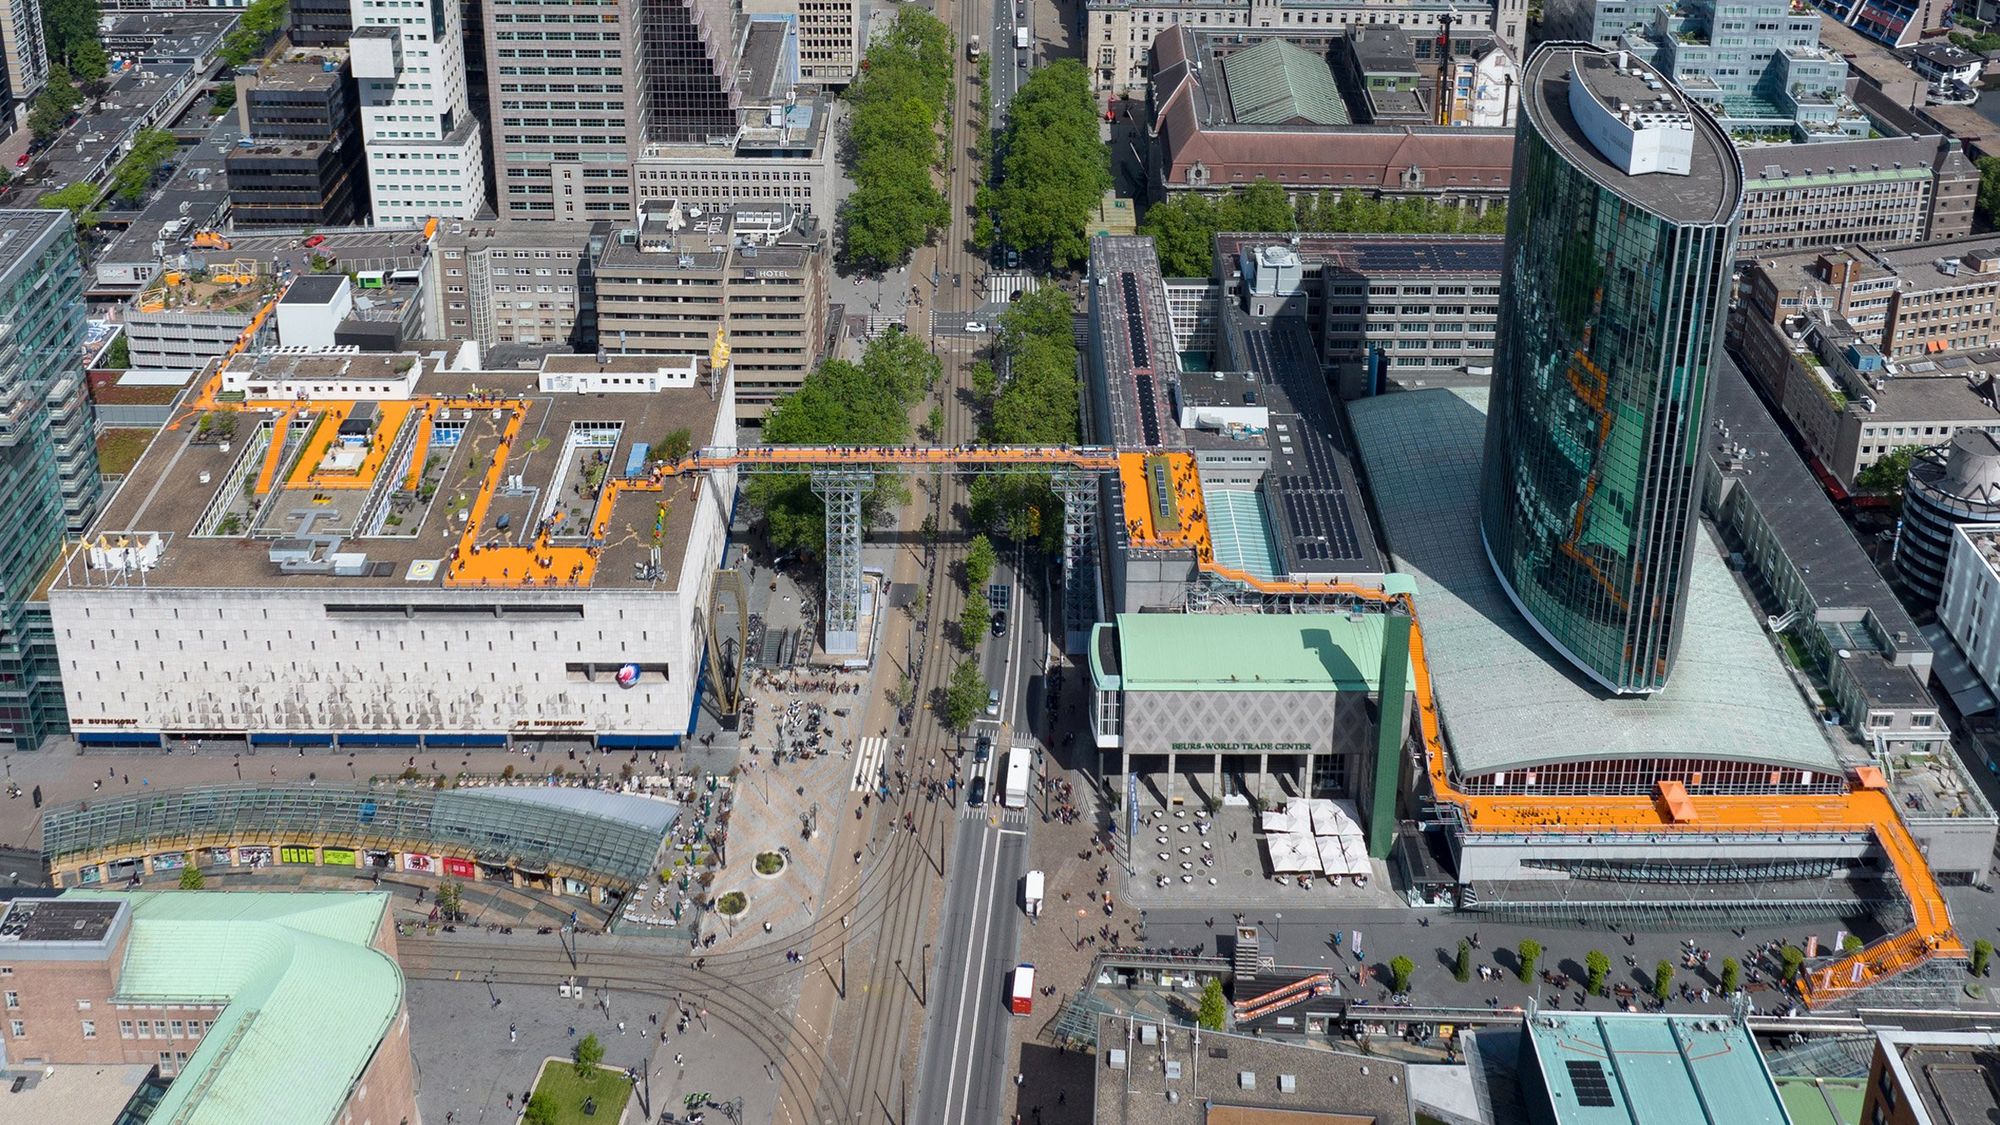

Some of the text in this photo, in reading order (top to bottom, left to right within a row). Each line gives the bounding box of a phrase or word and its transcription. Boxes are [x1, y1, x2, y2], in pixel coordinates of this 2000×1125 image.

[759, 270, 790, 278] HOTEL
[1241, 742, 1272, 750] TRADE
[1275, 742, 1312, 750] CENTER
